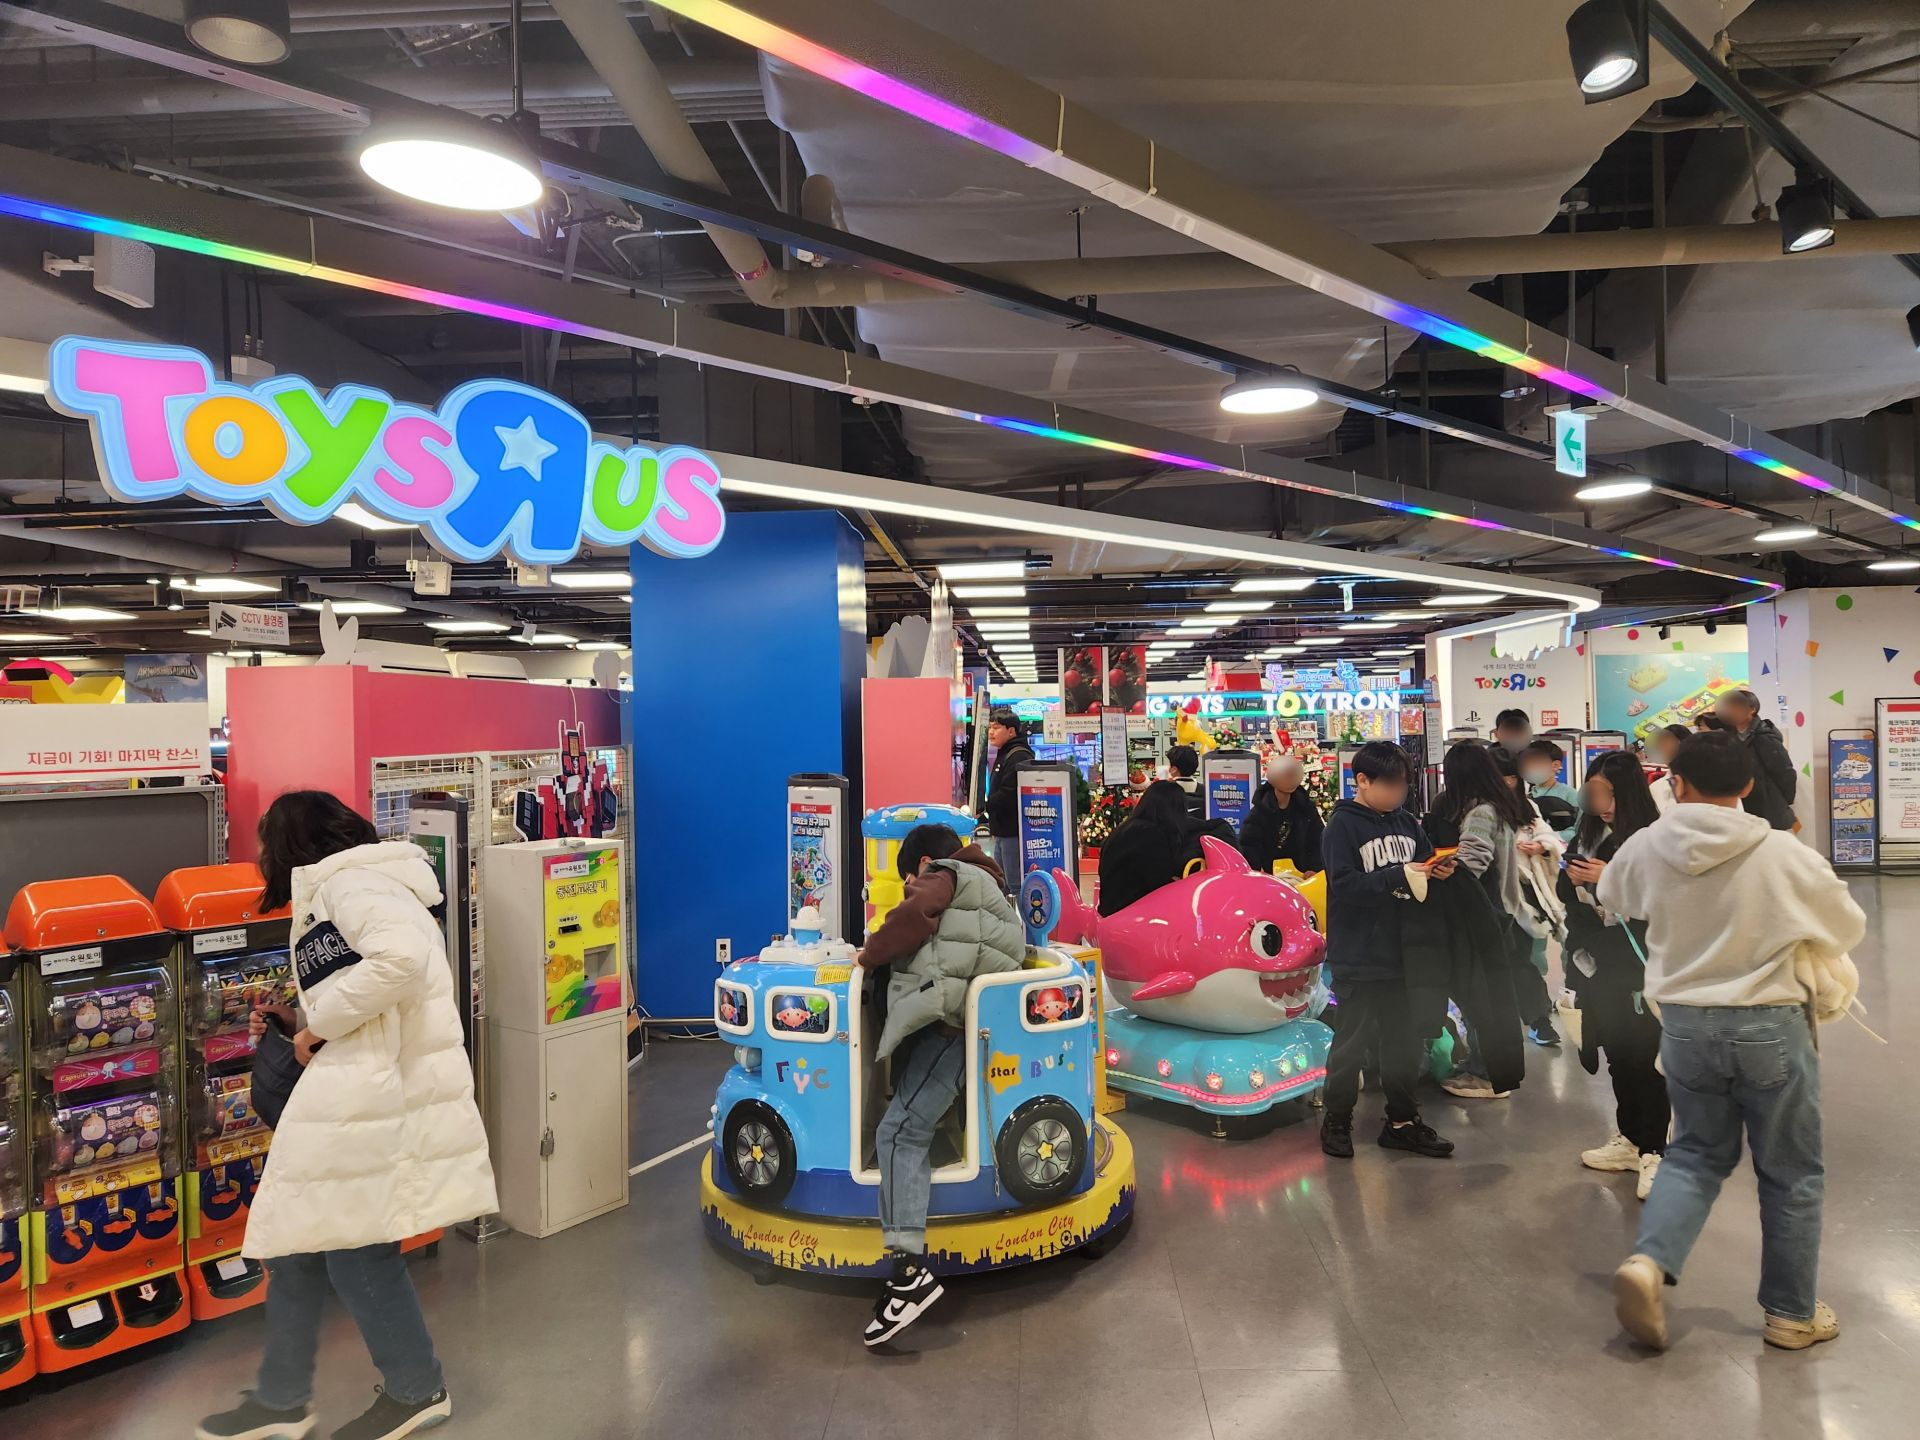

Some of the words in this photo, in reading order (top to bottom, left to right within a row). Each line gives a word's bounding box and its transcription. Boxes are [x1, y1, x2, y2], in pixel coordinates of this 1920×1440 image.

[241, 612, 261, 624] CCTV
[1262, 691, 1399, 717] TOYTRON
[27, 751, 72, 765] 지금이
[79, 751, 112, 764] 기회!
[118, 749, 160, 762] 마지막
[166, 748, 198, 761] 찬스!
[1028, 817, 1055, 826] WONDER
[556, 879, 608, 900] 동전교환기
[990, 1067, 1016, 1078] Star
[744, 1224, 785, 1244] London
[788, 1229, 819, 1249] City
[995, 1228, 1043, 1251] London
[1048, 1215, 1074, 1237] City
